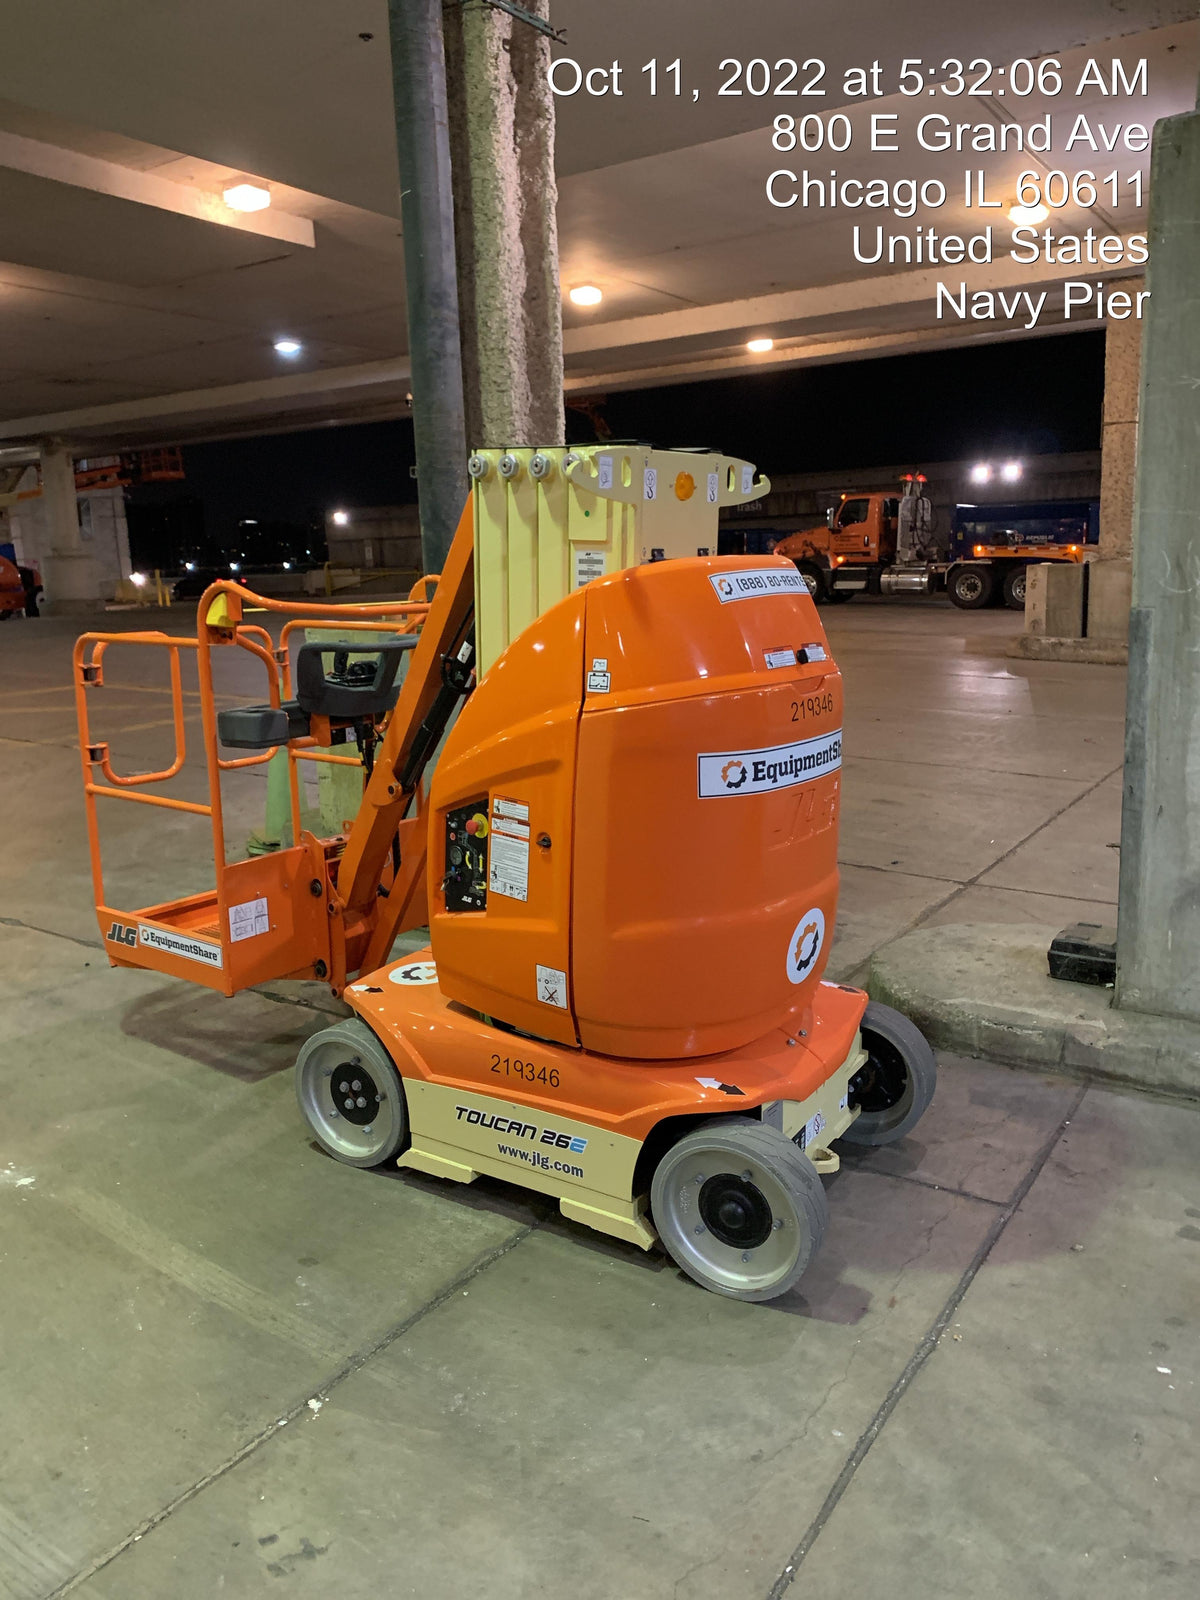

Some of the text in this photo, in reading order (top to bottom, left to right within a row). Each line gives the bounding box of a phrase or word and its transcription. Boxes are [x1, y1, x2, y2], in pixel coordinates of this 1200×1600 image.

[736, 575, 768, 591] (888)
[791, 693, 833, 722] 219346
[107, 923, 137, 947] JLG
[150, 932, 218, 961] EquipmentShare
[490, 1054, 560, 1088] 219346
[456, 1106, 587, 1154] TOUCAN 26E
[497, 1143, 584, 1178] www.jlg.com
